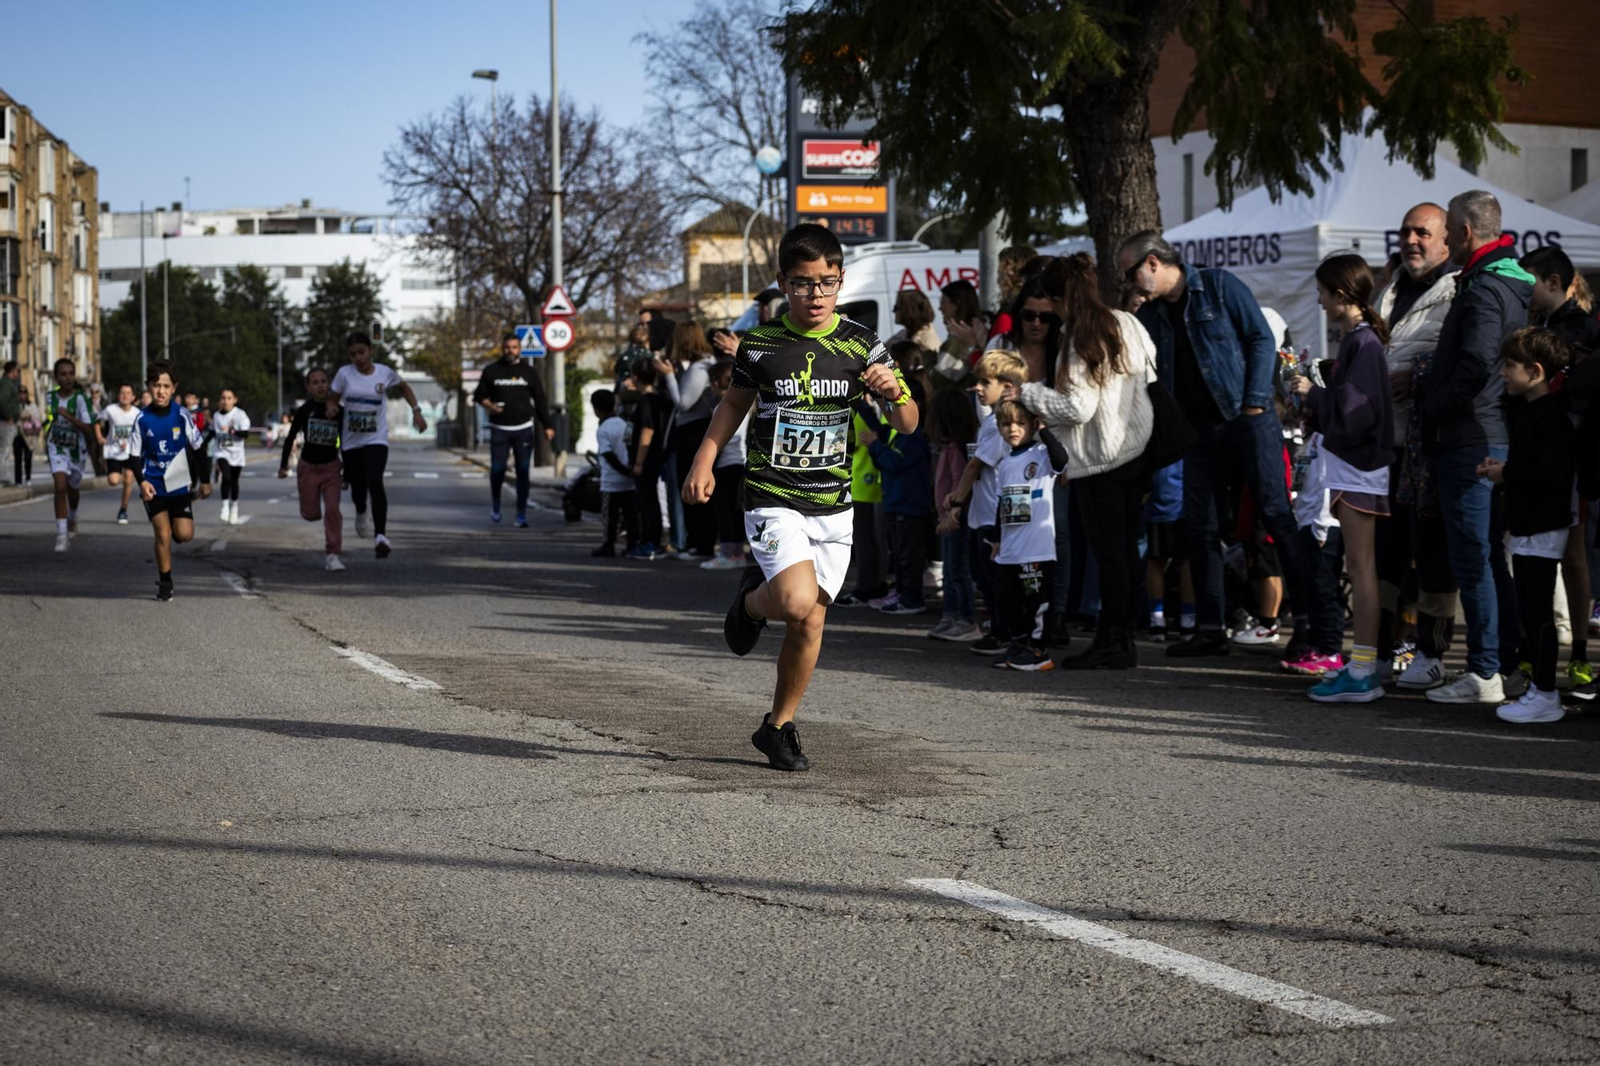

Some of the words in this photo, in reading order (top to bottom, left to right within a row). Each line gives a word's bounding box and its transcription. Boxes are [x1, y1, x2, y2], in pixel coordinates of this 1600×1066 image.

[551, 329, 567, 339] 30
[780, 411, 805, 420] CARRERA
[789, 418, 821, 427] BOMBEROS
[782, 427, 827, 454] 521
